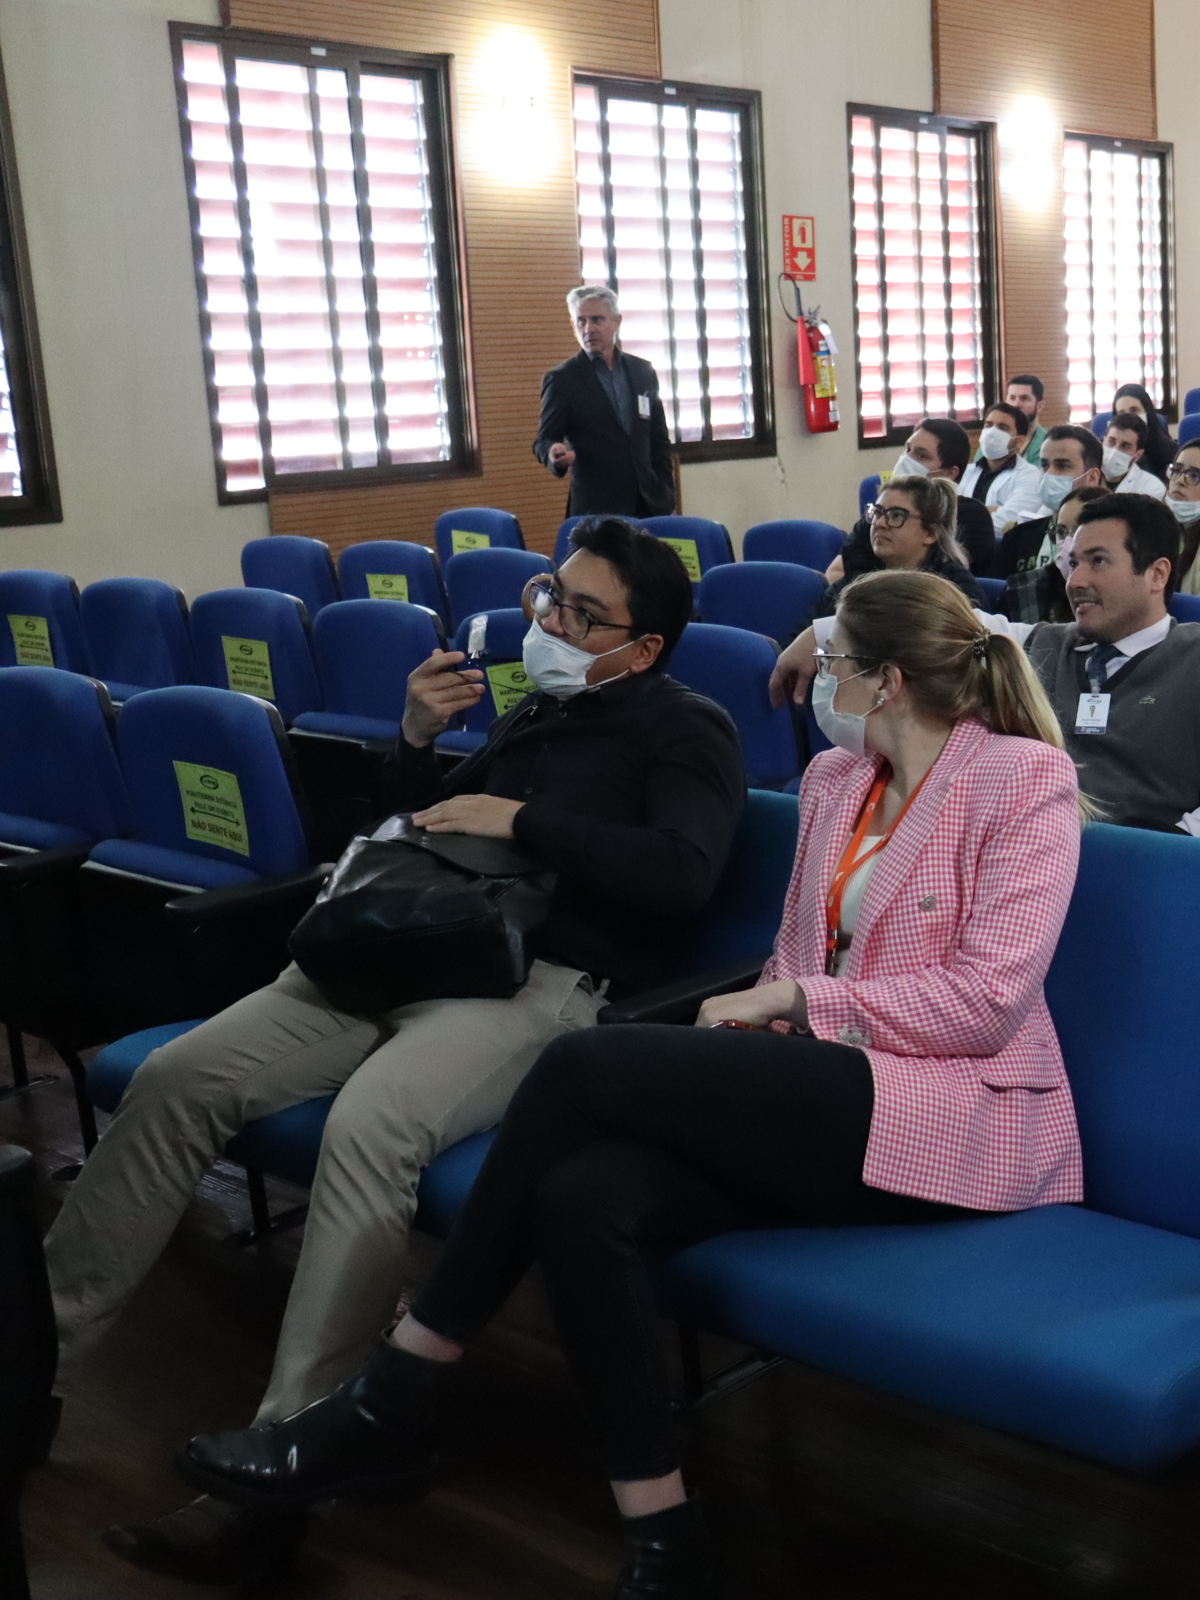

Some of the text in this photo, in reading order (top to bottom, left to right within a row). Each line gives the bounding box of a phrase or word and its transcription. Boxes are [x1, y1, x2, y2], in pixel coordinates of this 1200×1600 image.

[783, 217, 791, 272] EXTINTOR
[185, 789, 215, 801] MANTENHA
[191, 818, 244, 842] NÃO SENTE AQUI
